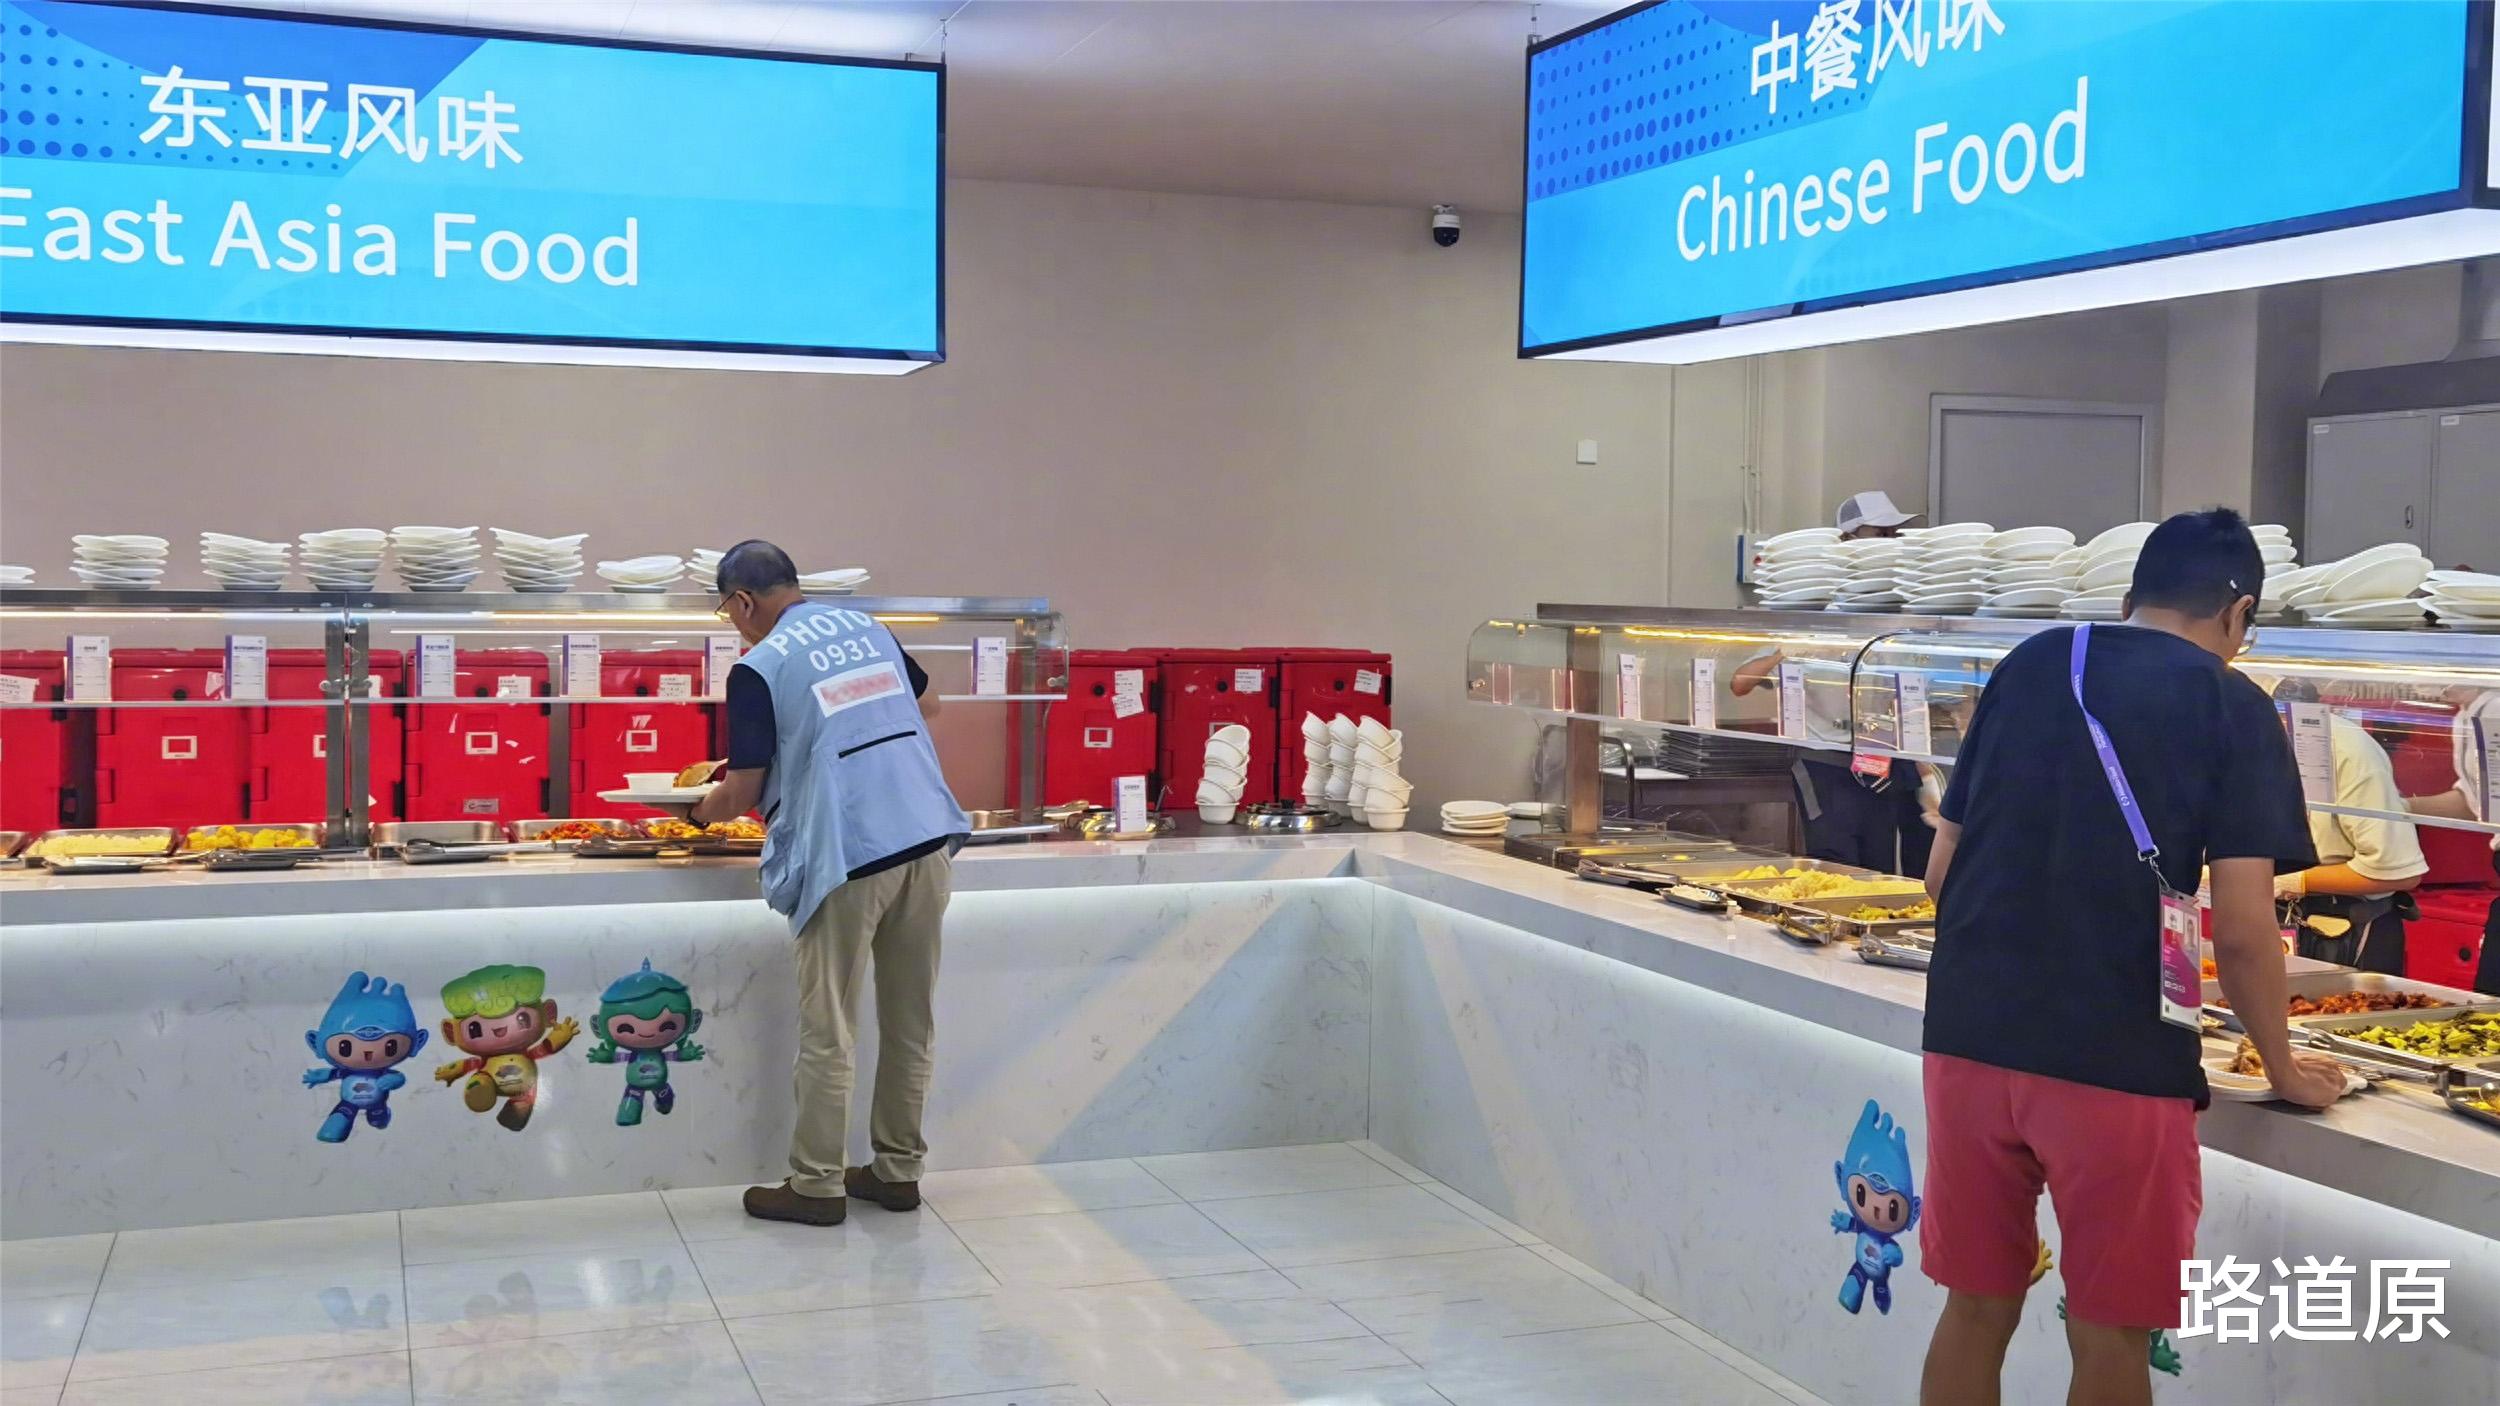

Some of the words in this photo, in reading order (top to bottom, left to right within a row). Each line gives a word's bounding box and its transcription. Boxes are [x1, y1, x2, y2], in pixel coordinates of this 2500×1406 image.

[139, 65, 523, 169] 东亚风味
[1676, 159, 1890, 262] Chinese
[1912, 77, 2088, 213] Food
[0, 188, 184, 266] East
[210, 201, 396, 276] Asia
[434, 213, 638, 287] Food
[767, 608, 872, 657] PHOTO
[809, 636, 881, 672] 0931
